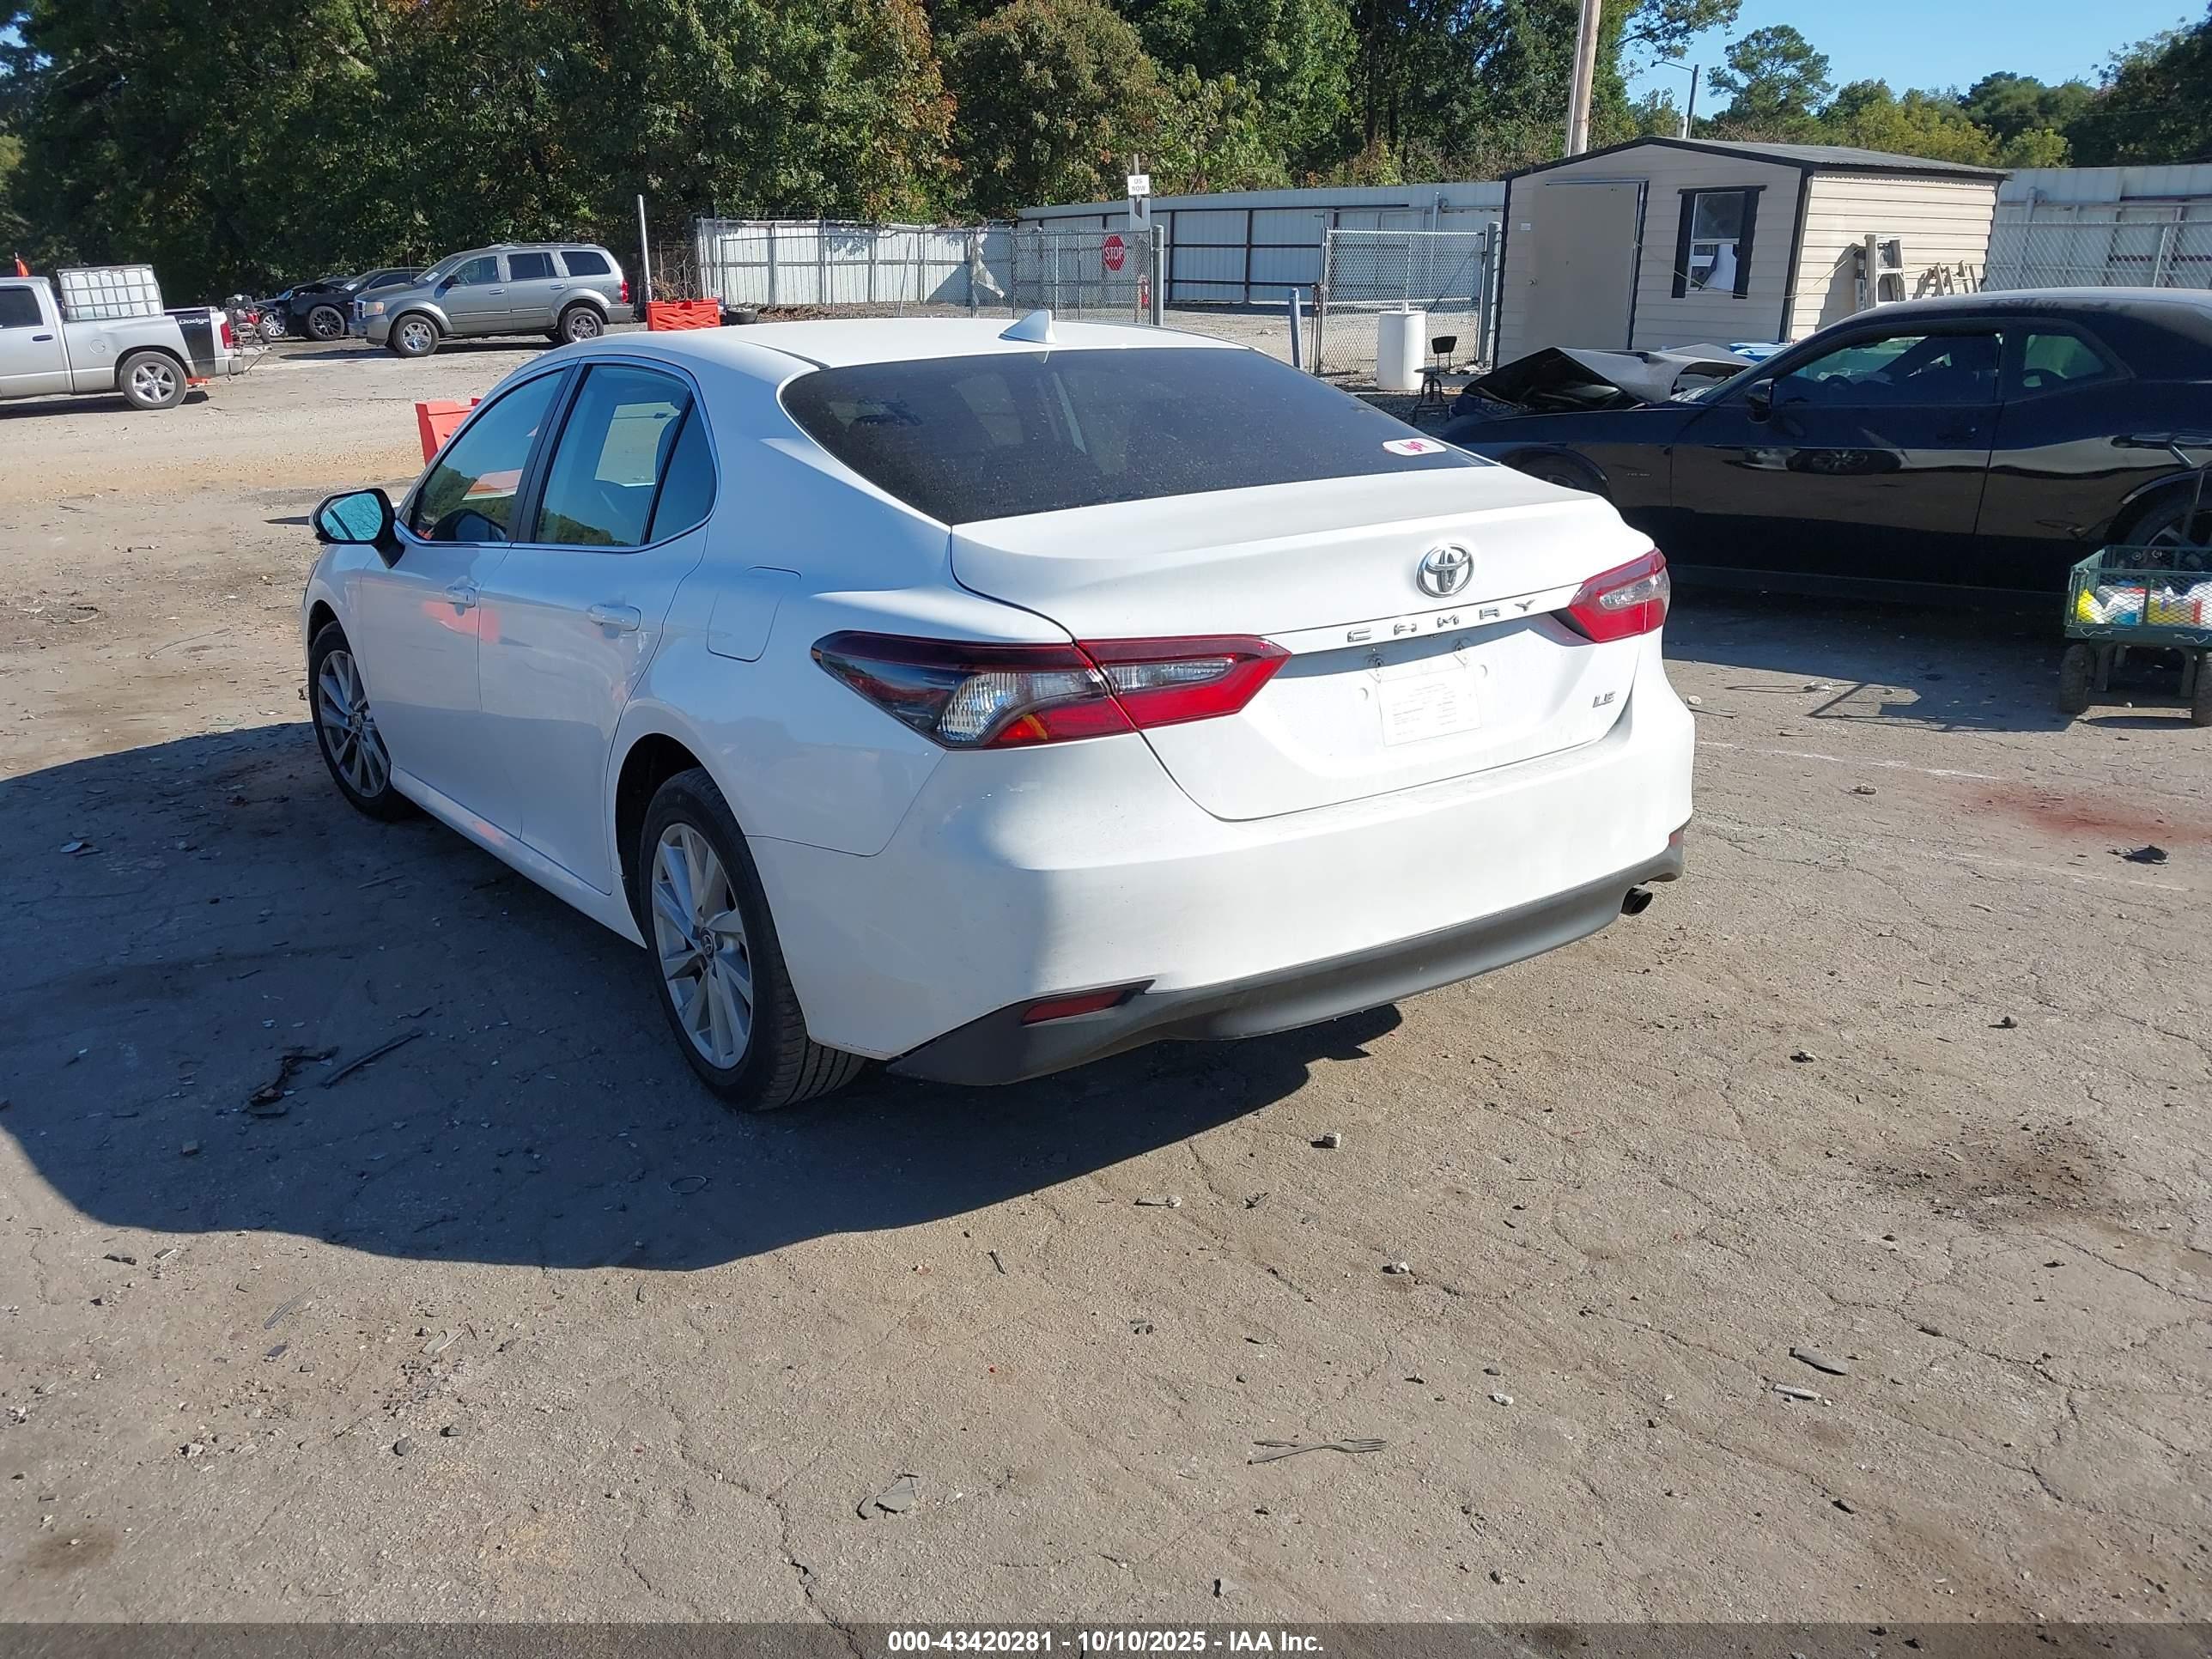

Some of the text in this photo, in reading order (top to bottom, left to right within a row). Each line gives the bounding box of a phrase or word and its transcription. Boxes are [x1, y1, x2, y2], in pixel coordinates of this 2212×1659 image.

[1104, 246, 1125, 261] STOP
[1346, 599, 1536, 643] CAMRY
[1592, 690, 1617, 708] LE
